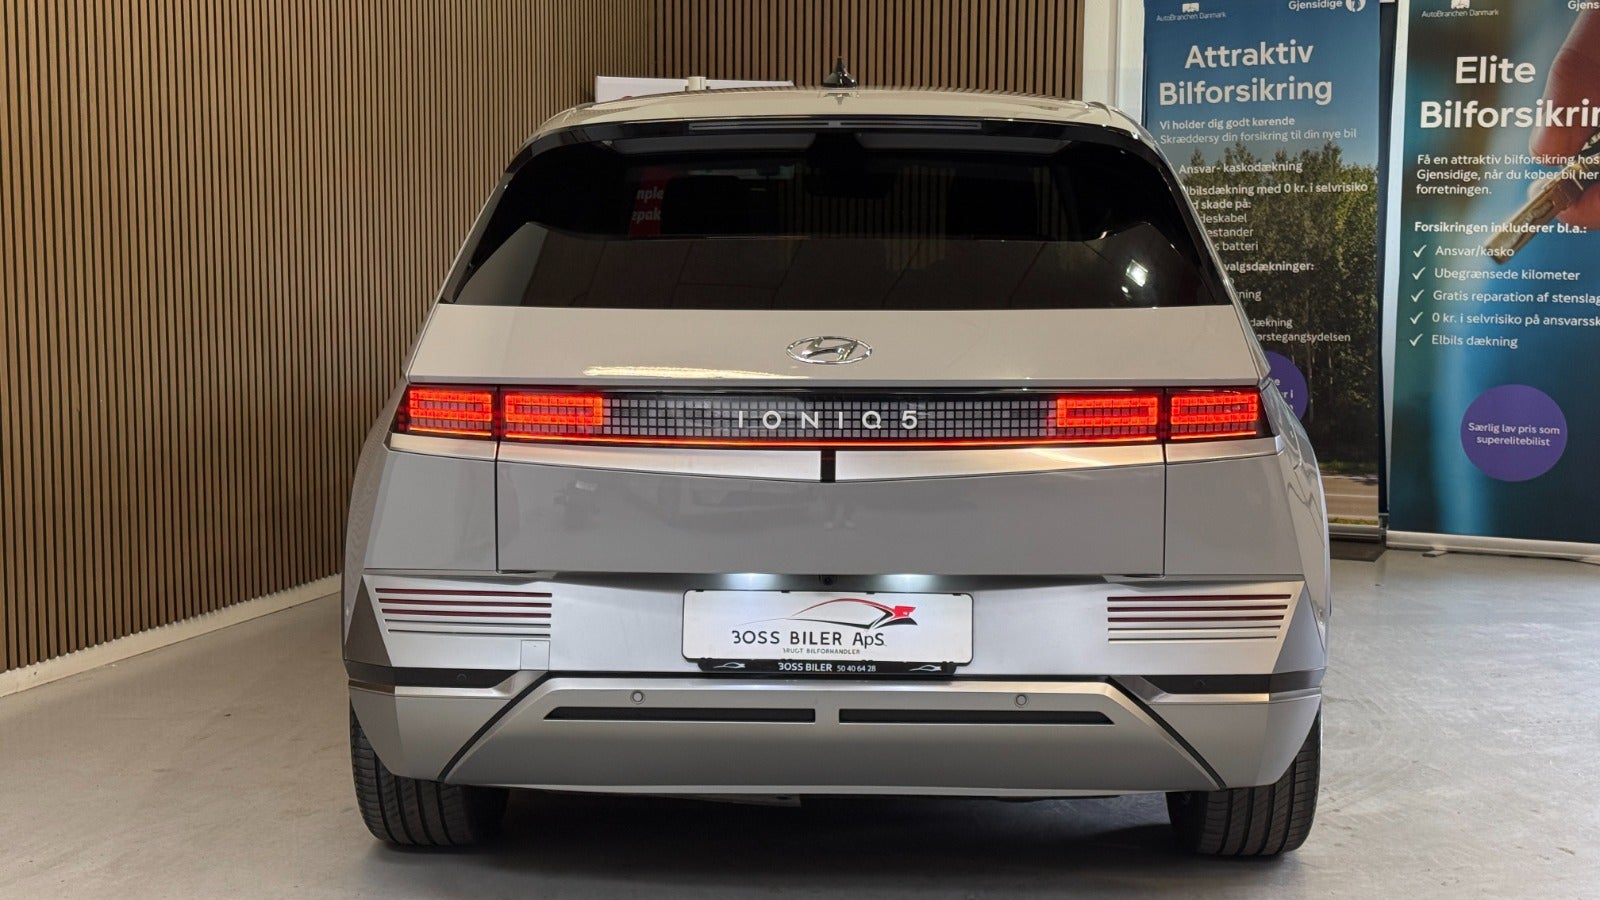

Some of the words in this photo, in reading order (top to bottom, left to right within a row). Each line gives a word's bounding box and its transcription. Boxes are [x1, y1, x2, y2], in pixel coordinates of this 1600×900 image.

[1288, 0, 1343, 12] Gjensidige
[1421, 9, 1468, 19] AutoBranchen
[1469, 8, 1499, 17] Danmark
[1567, 0, 1600, 12] Gjens
[1156, 13, 1198, 22] AutoBranchen
[1199, 11, 1227, 20] Danmark
[1184, 39, 1314, 69] Attraktiv
[1455, 54, 1536, 84] Elite
[1159, 76, 1333, 106] Bilforsikring
[1159, 120, 1171, 130] Vi
[1172, 119, 1206, 130] holder
[1208, 118, 1224, 131] dig
[1226, 117, 1250, 131] godt
[1252, 116, 1295, 128] kørende
[1160, 134, 1219, 146] Skræddersy
[1222, 132, 1238, 143] din
[1240, 131, 1288, 144] forsikring
[1290, 130, 1302, 140] til
[1304, 129, 1321, 140] din
[1323, 131, 1342, 142] nye
[1344, 128, 1357, 139] bil
[1223, 161, 1303, 174] kaskodækning
[1417, 154, 1430, 165] Få
[1433, 156, 1448, 165] en
[1451, 154, 1502, 165] attraktiv
[1504, 154, 1575, 168] bilforsikring
[1577, 154, 1599, 165] hos
[1416, 170, 1481, 182] Gjensidige,
[1484, 169, 1503, 180] når
[1506, 168, 1522, 180] du
[1524, 169, 1559, 180] køber
[1561, 168, 1576, 180] bil
[1578, 169, 1599, 180] her
[1186, 184, 1254, 197] lbilsdækning
[1256, 184, 1282, 195] med
[1284, 183, 1291, 194] 0
[1294, 182, 1308, 194] kr.
[1315, 181, 1368, 193] selvrisiko
[1416, 183, 1492, 197] forretningen.
[1201, 199, 1233, 210] skade
[1235, 199, 1252, 212] på:
[1200, 213, 1247, 225] deskabel
[1208, 227, 1253, 238] estander
[1414, 221, 1488, 234] Forsikringen
[1491, 222, 1554, 234] inkluderer
[1557, 222, 1588, 234] bl.a.:
[1222, 240, 1259, 251] batteri
[1434, 244, 1515, 259] Ansvar/kasko
[1224, 261, 1315, 274] valgsdækninger:
[1434, 267, 1519, 282] Ubegrænsede
[1521, 269, 1581, 282] kilometer
[1433, 290, 1469, 302] Gratis
[1471, 291, 1534, 304] reparation
[1536, 291, 1549, 303] af
[1251, 317, 1293, 329] dækning
[1431, 312, 1440, 323] 0
[1442, 312, 1457, 324] kr.
[1466, 313, 1522, 325] selvrisiko
[1525, 312, 1540, 328] på
[1543, 314, 1600, 327] ansvarssk
[1431, 334, 1463, 347] Elbils
[1466, 335, 1519, 349] dækning
[738, 410, 882, 430] IONIQ
[901, 410, 918, 430] 5
[1468, 421, 1500, 434] Særlig
[1502, 423, 1516, 433] lav
[1518, 424, 1537, 435] pris
[1539, 426, 1560, 435] som
[1476, 435, 1551, 448] superelitebilist
[790, 631, 842, 646] BILER
[805, 662, 833, 672] BILER
[837, 664, 846, 673] 50
[847, 664, 857, 673] 40
[857, 664, 867, 673] 64
